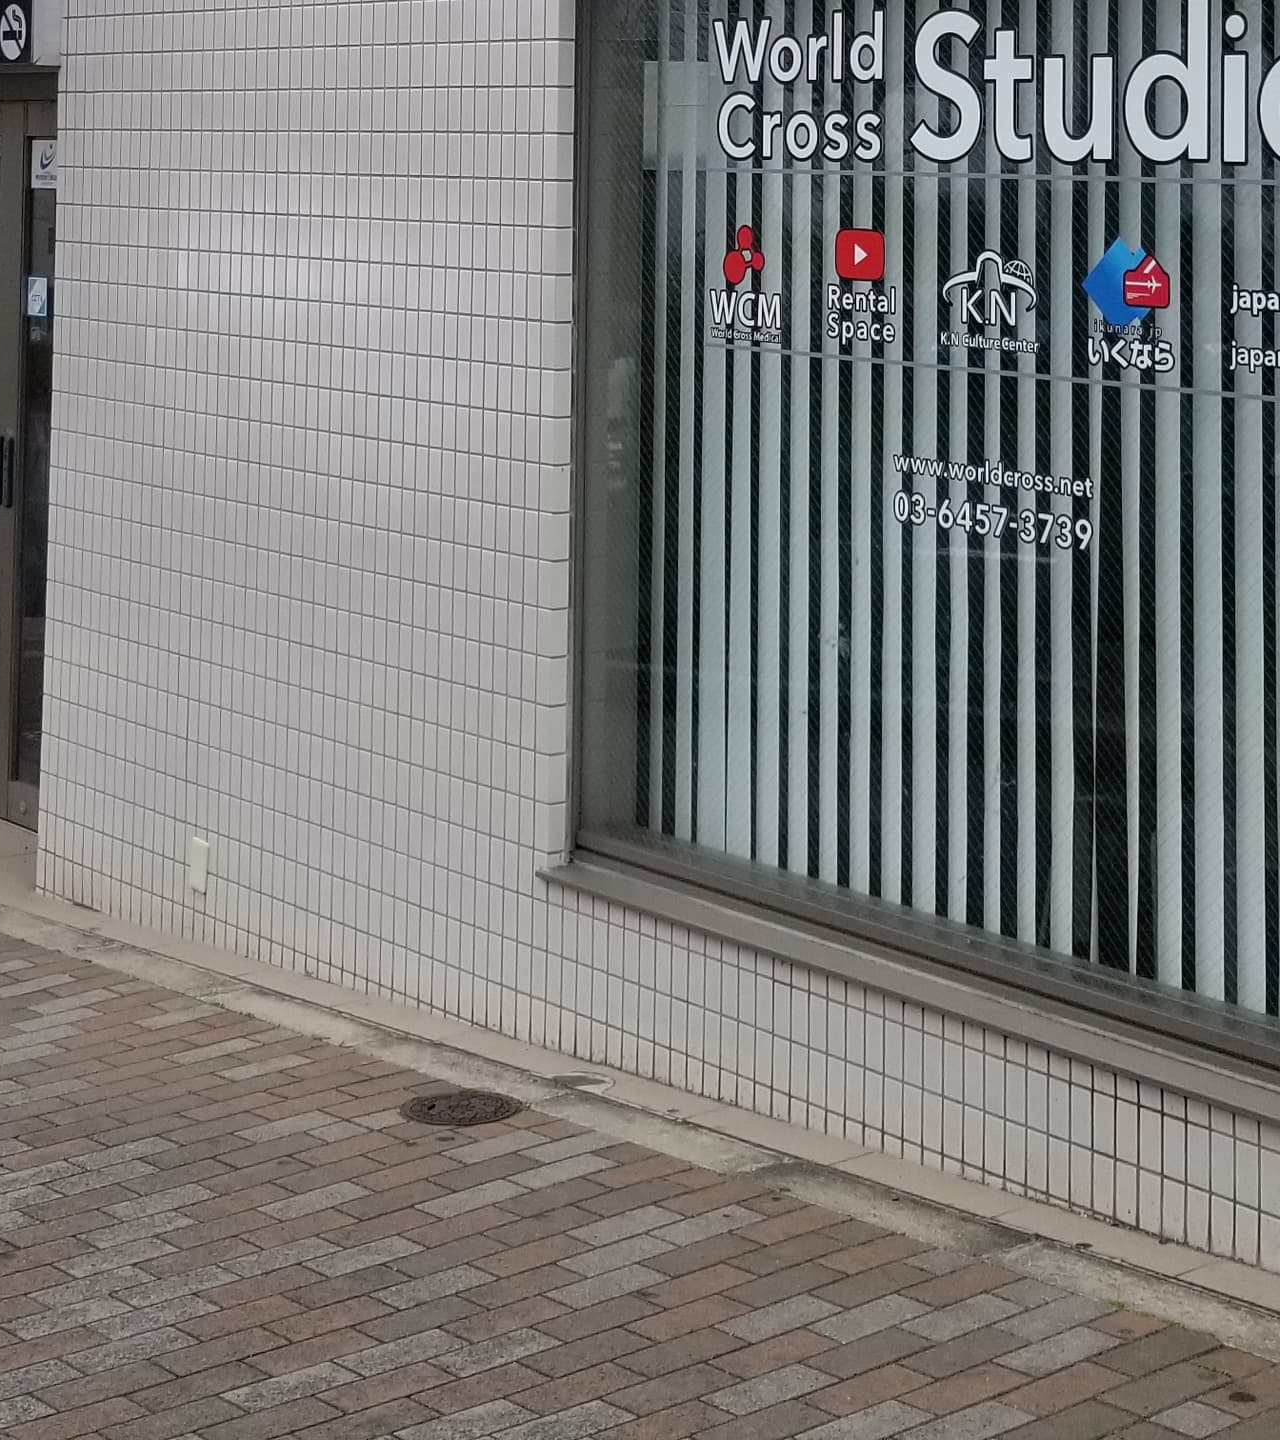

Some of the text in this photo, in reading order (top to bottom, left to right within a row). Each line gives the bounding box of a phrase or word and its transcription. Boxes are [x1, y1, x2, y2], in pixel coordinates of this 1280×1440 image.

[712, 7, 886, 85] World
[715, 91, 883, 161] Cross
[709, 288, 782, 329] WCM
[826, 283, 897, 314] Rental
[710, 327, 782, 343] World Cross Medical
[826, 313, 896, 345] Space
[939, 330, 1040, 353] K.N Culture Center
[1086, 336, 1176, 373] いくなら
[892, 453, 1094, 499] www.worldcross.net
[893, 489, 1094, 552] 03-6457-3739
